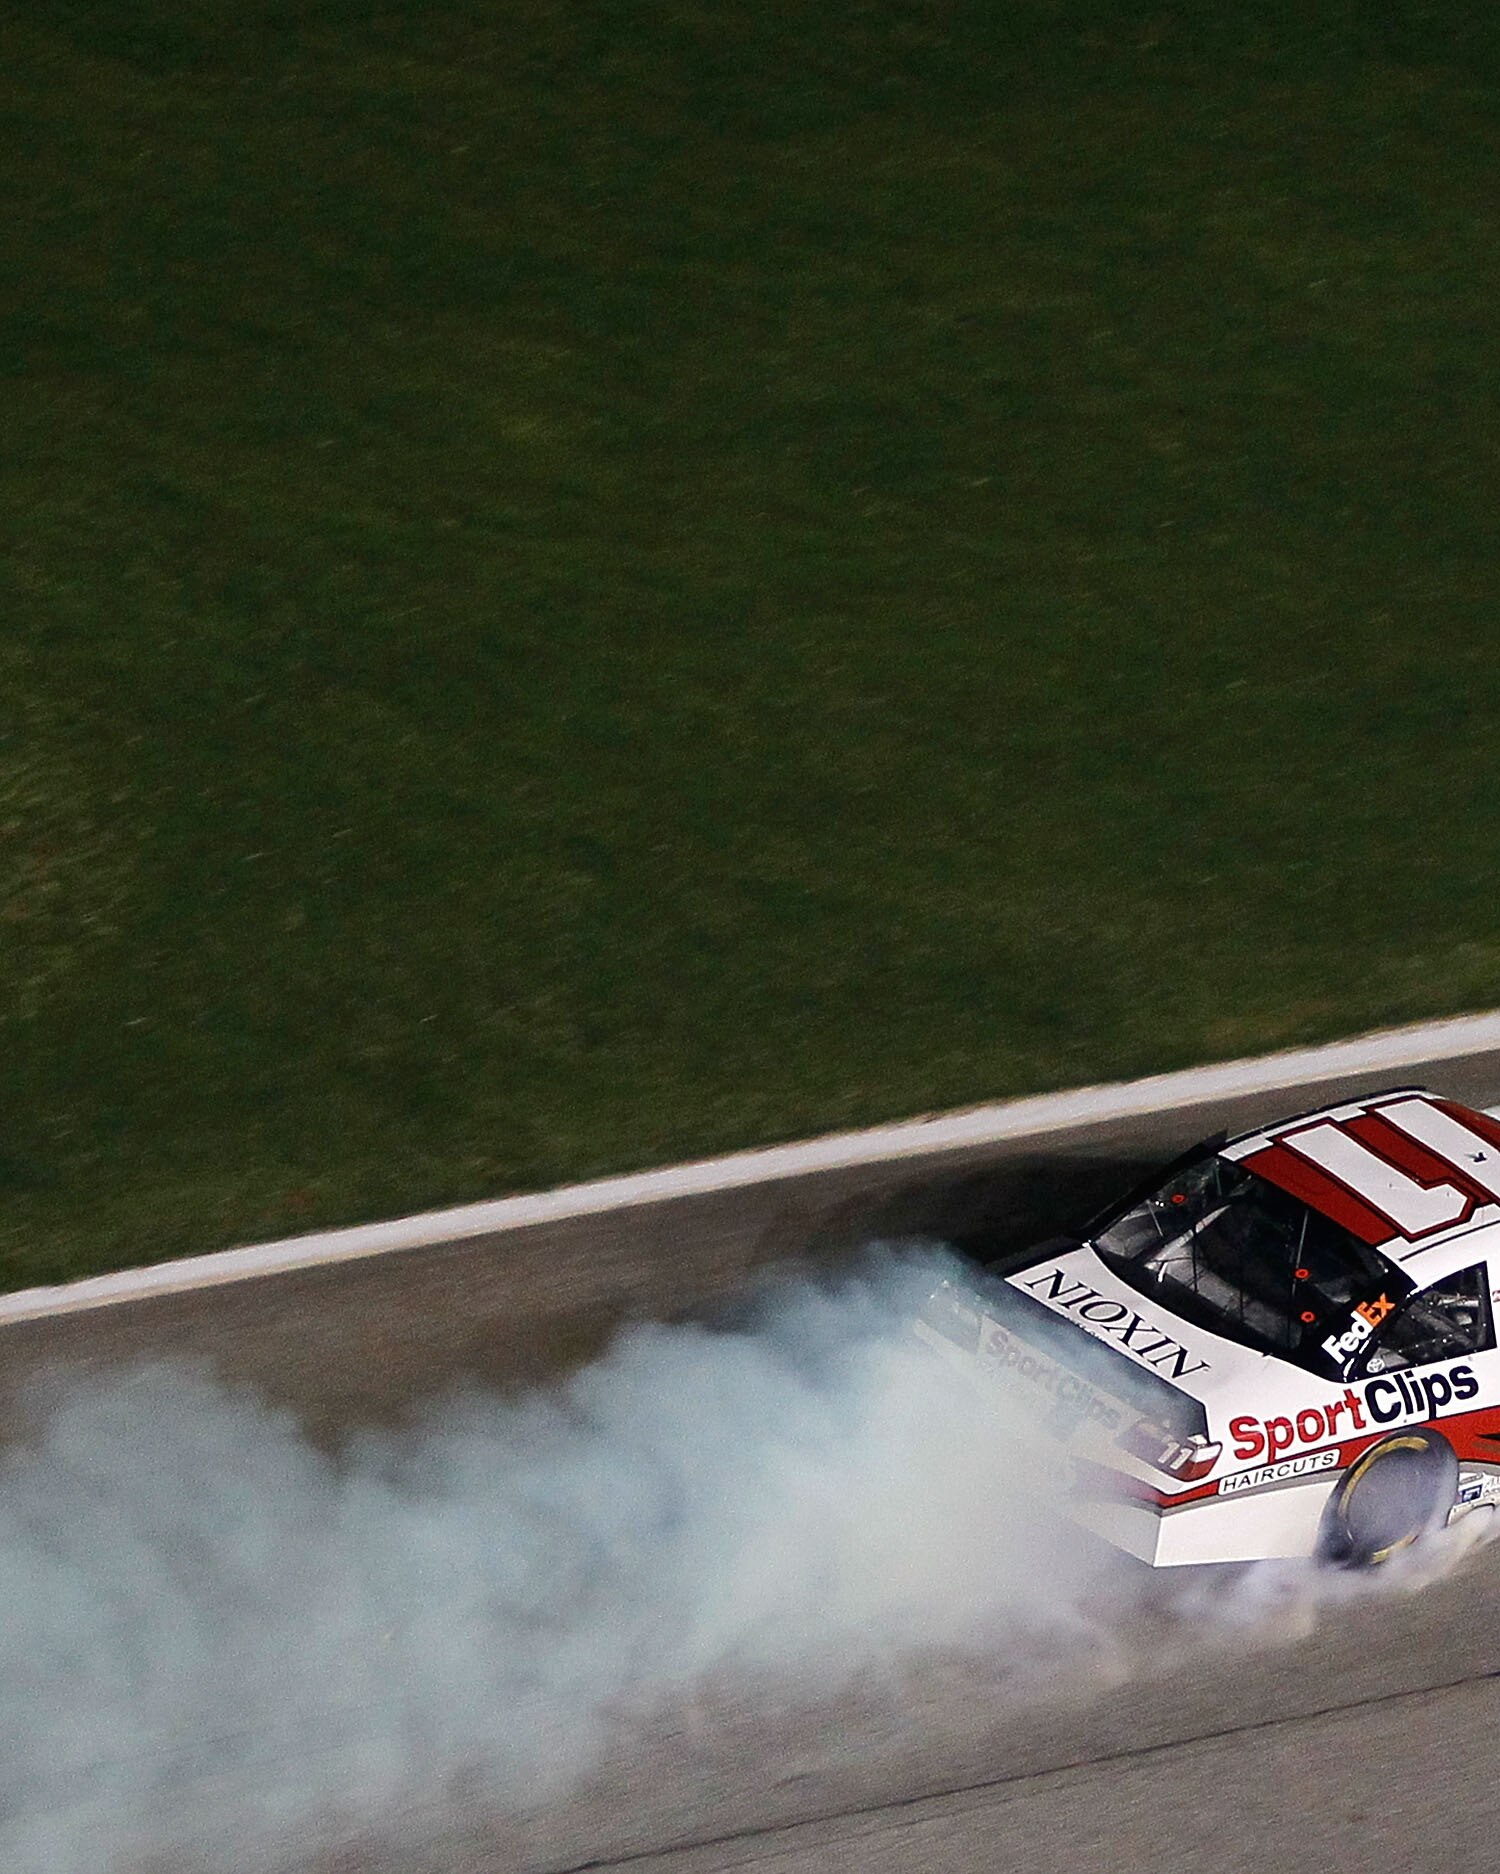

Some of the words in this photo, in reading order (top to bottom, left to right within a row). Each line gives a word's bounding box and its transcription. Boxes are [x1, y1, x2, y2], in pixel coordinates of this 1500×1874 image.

[1024, 1269, 1211, 1379] NIOXIN
[1321, 1292, 1395, 1364] FedEx
[1157, 1441, 1193, 1470] 11
[1224, 1453, 1334, 1491] HAIRCUTS
